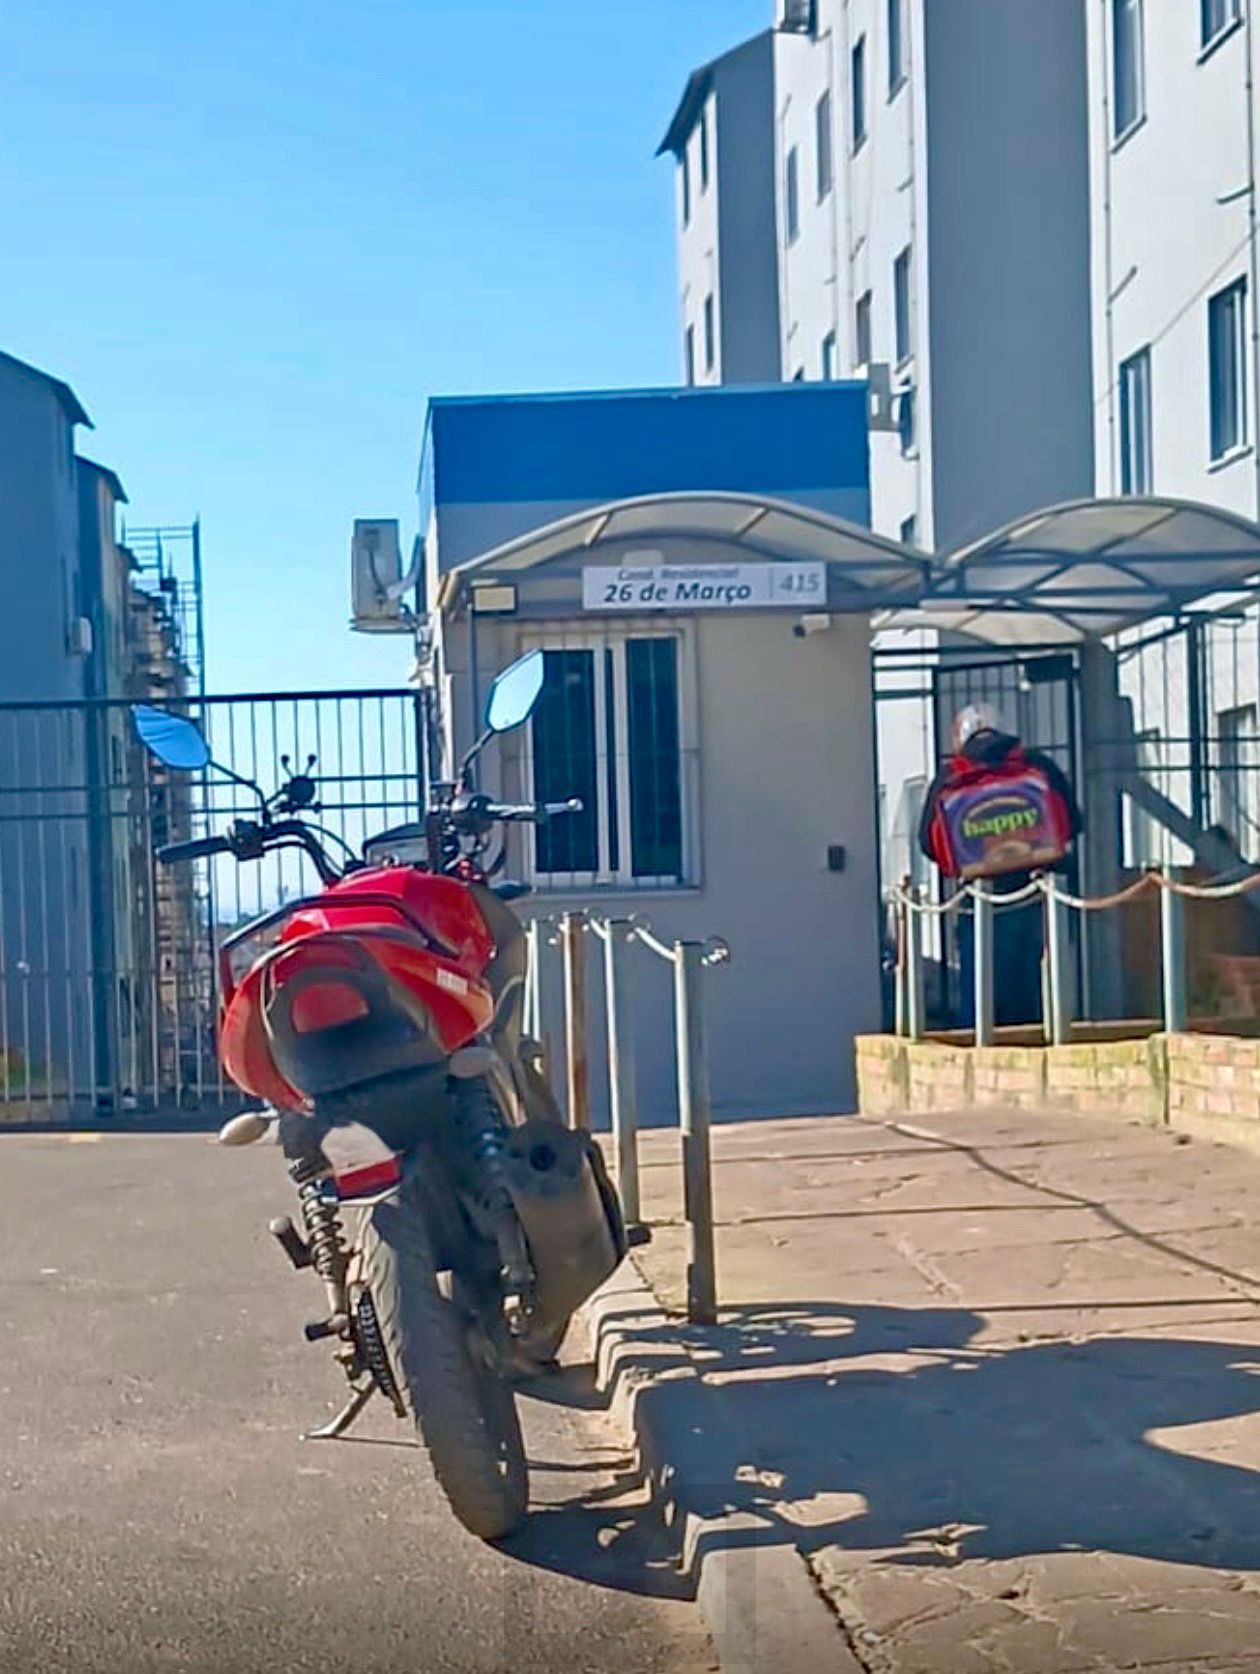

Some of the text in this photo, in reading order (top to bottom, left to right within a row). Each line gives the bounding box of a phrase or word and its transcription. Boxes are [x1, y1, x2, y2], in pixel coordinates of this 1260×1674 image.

[604, 581, 752, 604] 26 de Março
[779, 573, 820, 592] 415
[963, 807, 1038, 837] happy
